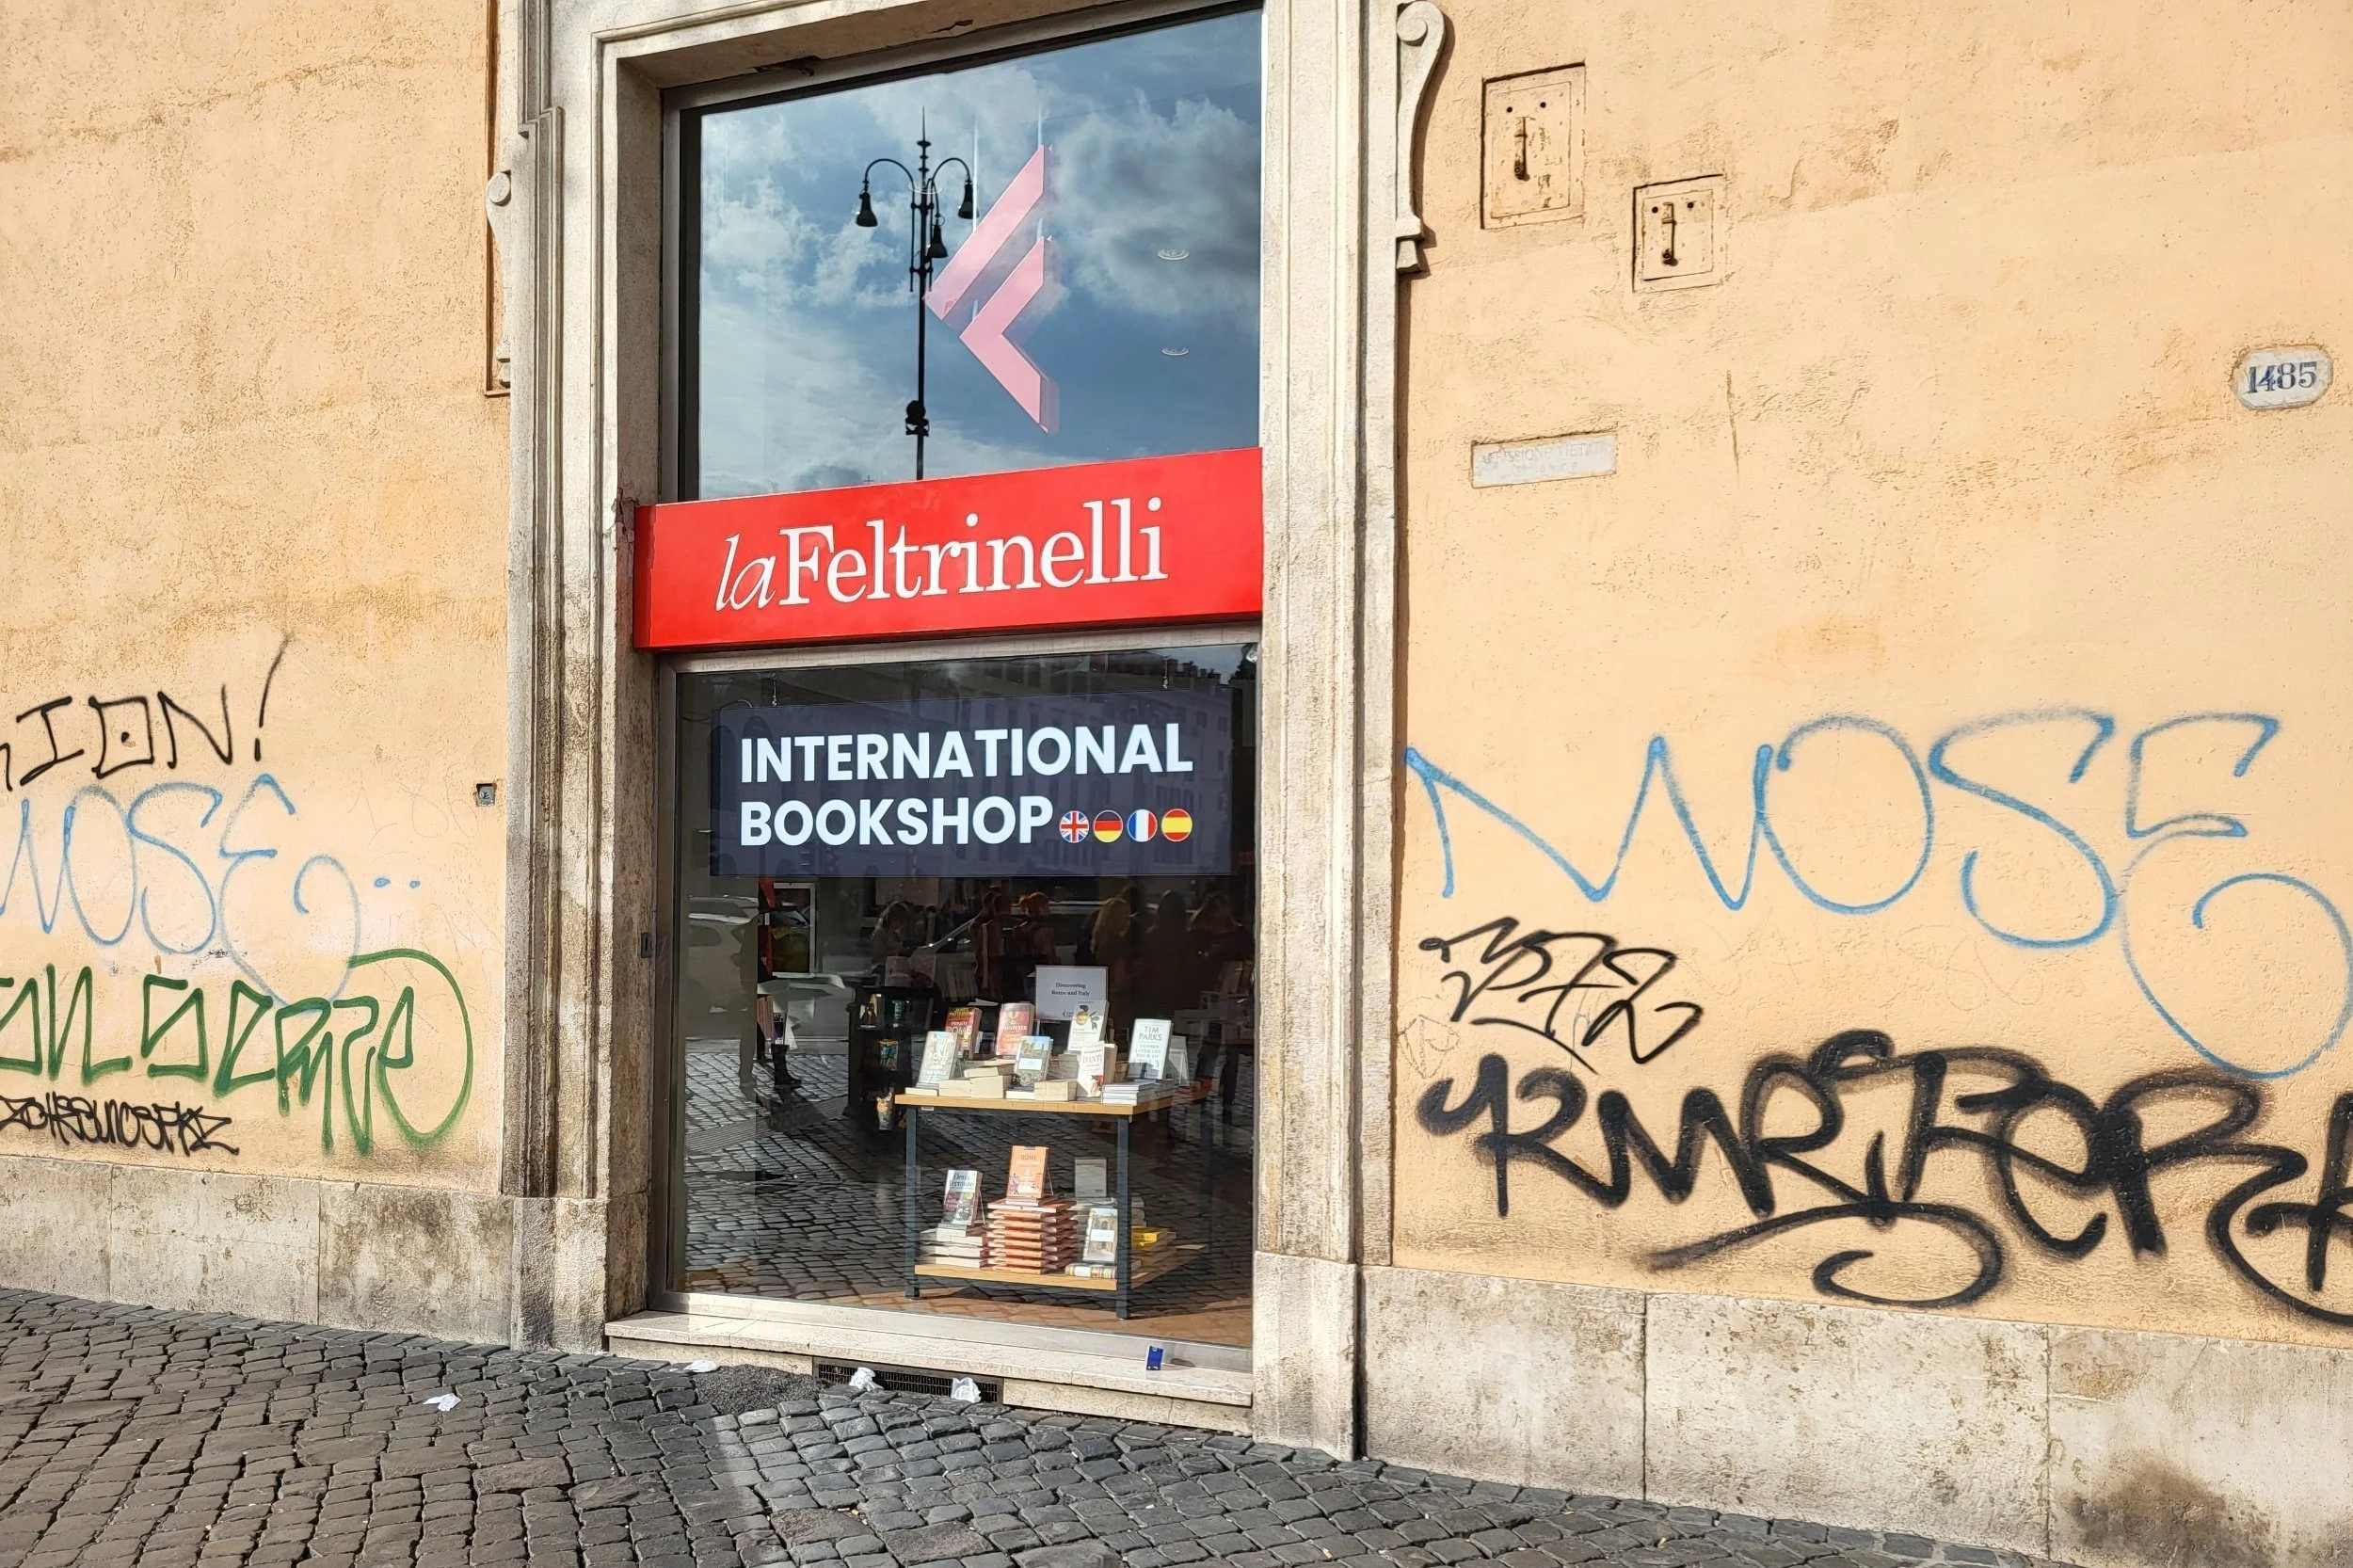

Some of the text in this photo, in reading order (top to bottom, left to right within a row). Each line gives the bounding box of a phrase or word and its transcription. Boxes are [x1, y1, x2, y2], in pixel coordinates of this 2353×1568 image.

[2243, 360, 2317, 393] 1485
[741, 723, 1193, 783] INTERNATIONAL
[741, 794, 1053, 847] BOOKSHOP
